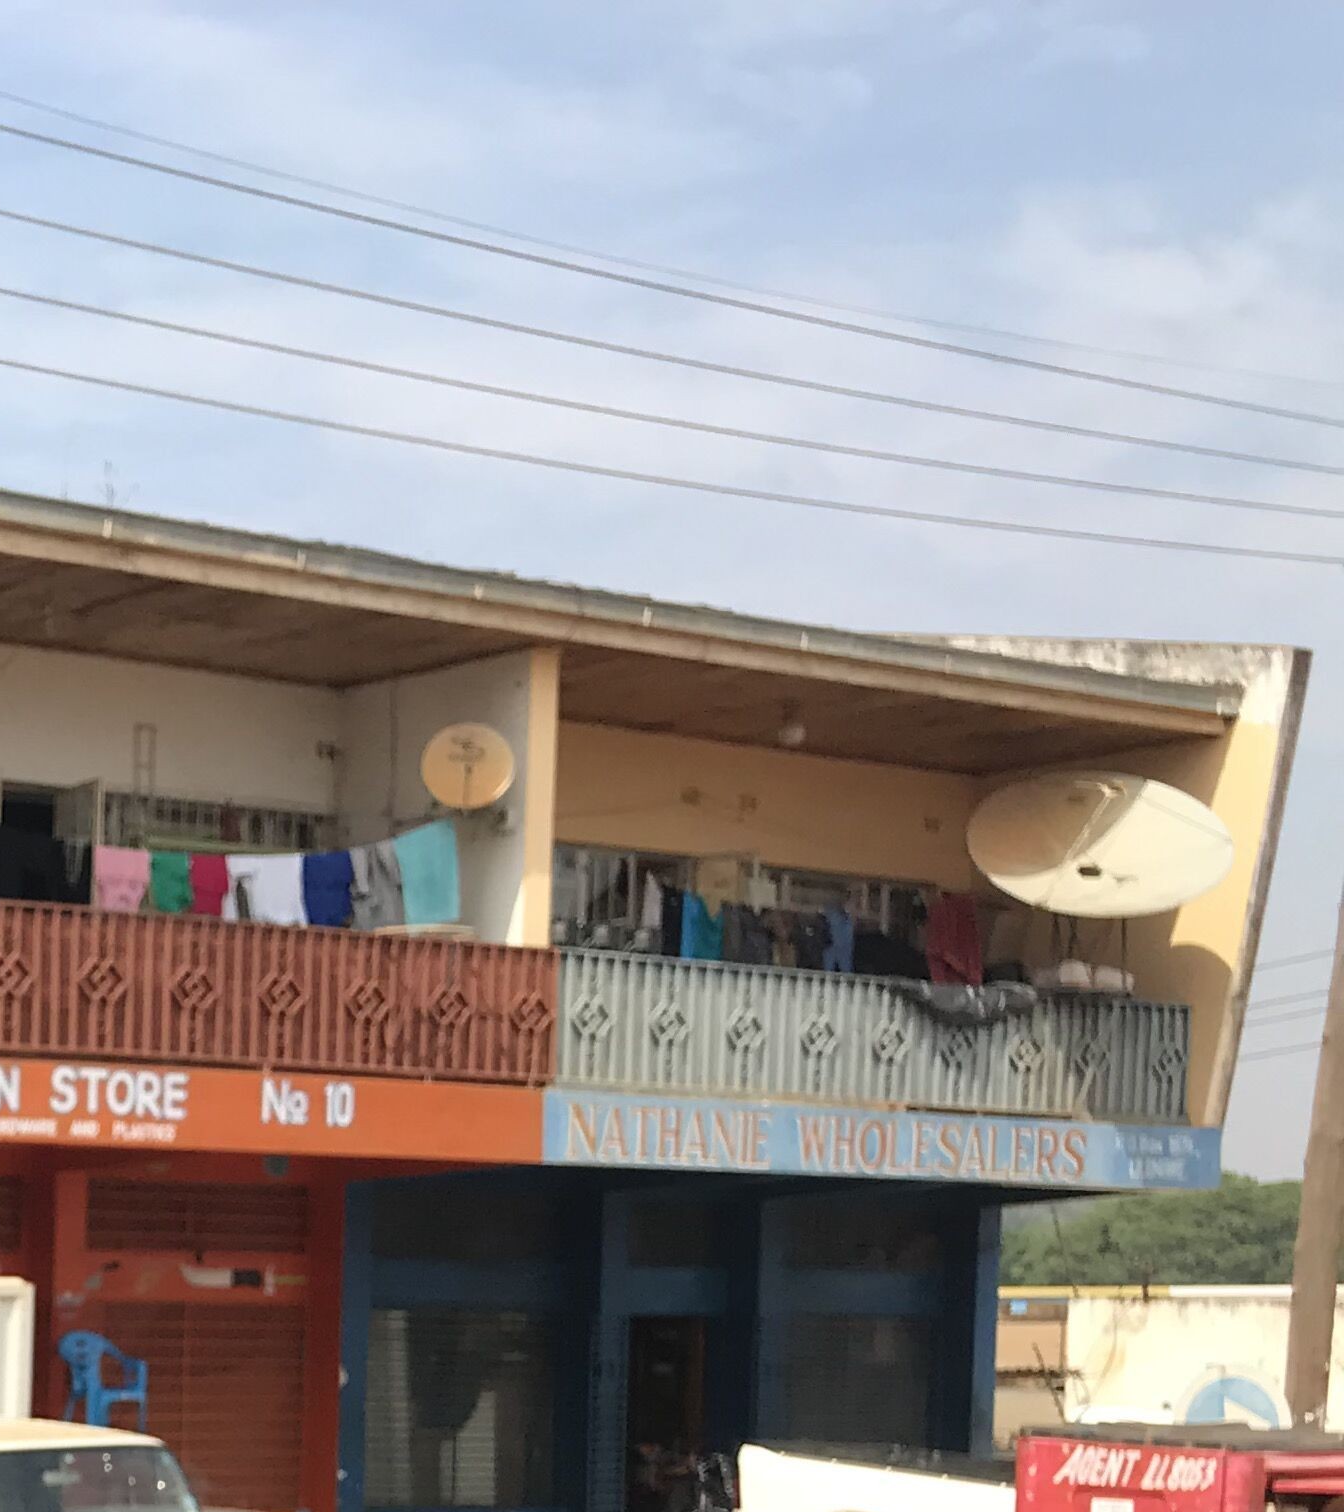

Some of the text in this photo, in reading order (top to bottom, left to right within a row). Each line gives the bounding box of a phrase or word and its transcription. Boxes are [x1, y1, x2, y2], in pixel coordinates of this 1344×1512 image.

[49, 1065, 189, 1121] STORE
[324, 1081, 355, 1128] 10
[797, 1115, 1088, 1183] WHOLESALERS
